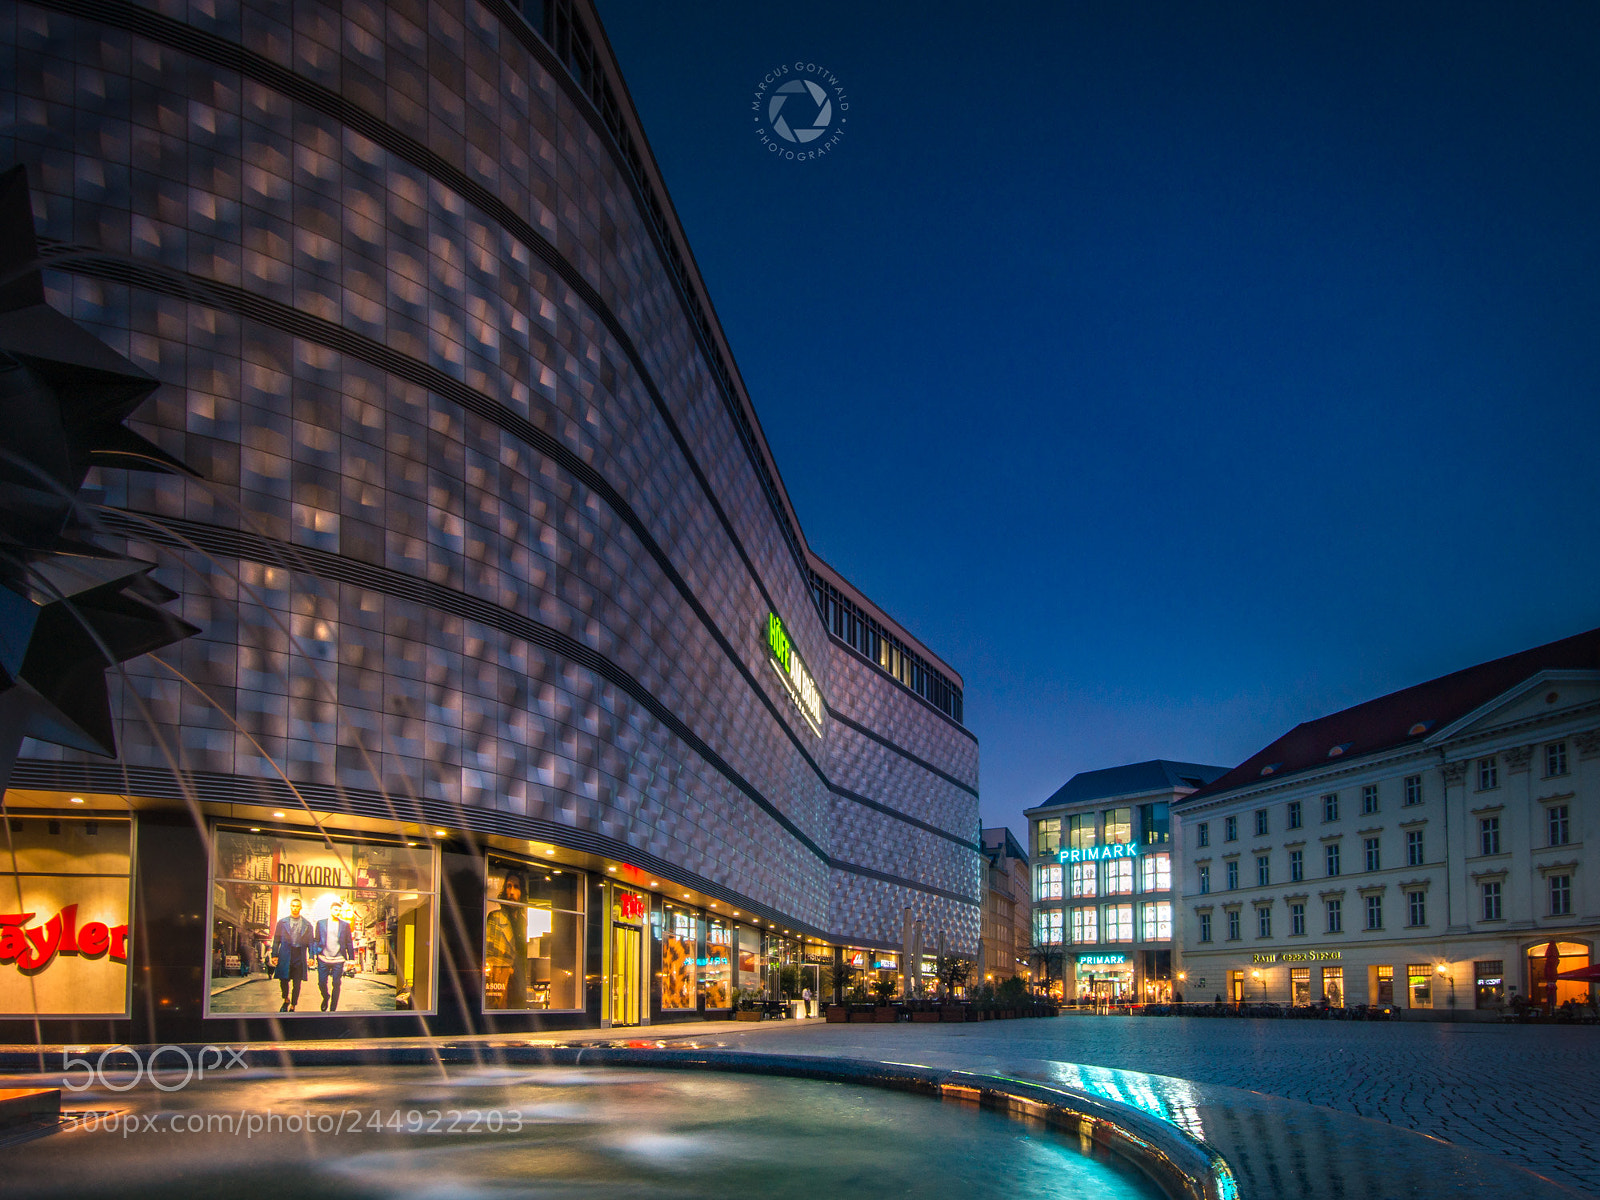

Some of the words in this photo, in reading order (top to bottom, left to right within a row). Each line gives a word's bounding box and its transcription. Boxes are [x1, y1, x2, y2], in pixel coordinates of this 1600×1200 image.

[769, 612, 790, 674] HÖFE
[1060, 842, 1137, 864] PRIMARK
[277, 863, 341, 887] DRYKORN
[1080, 955, 1125, 965] PRIMARK
